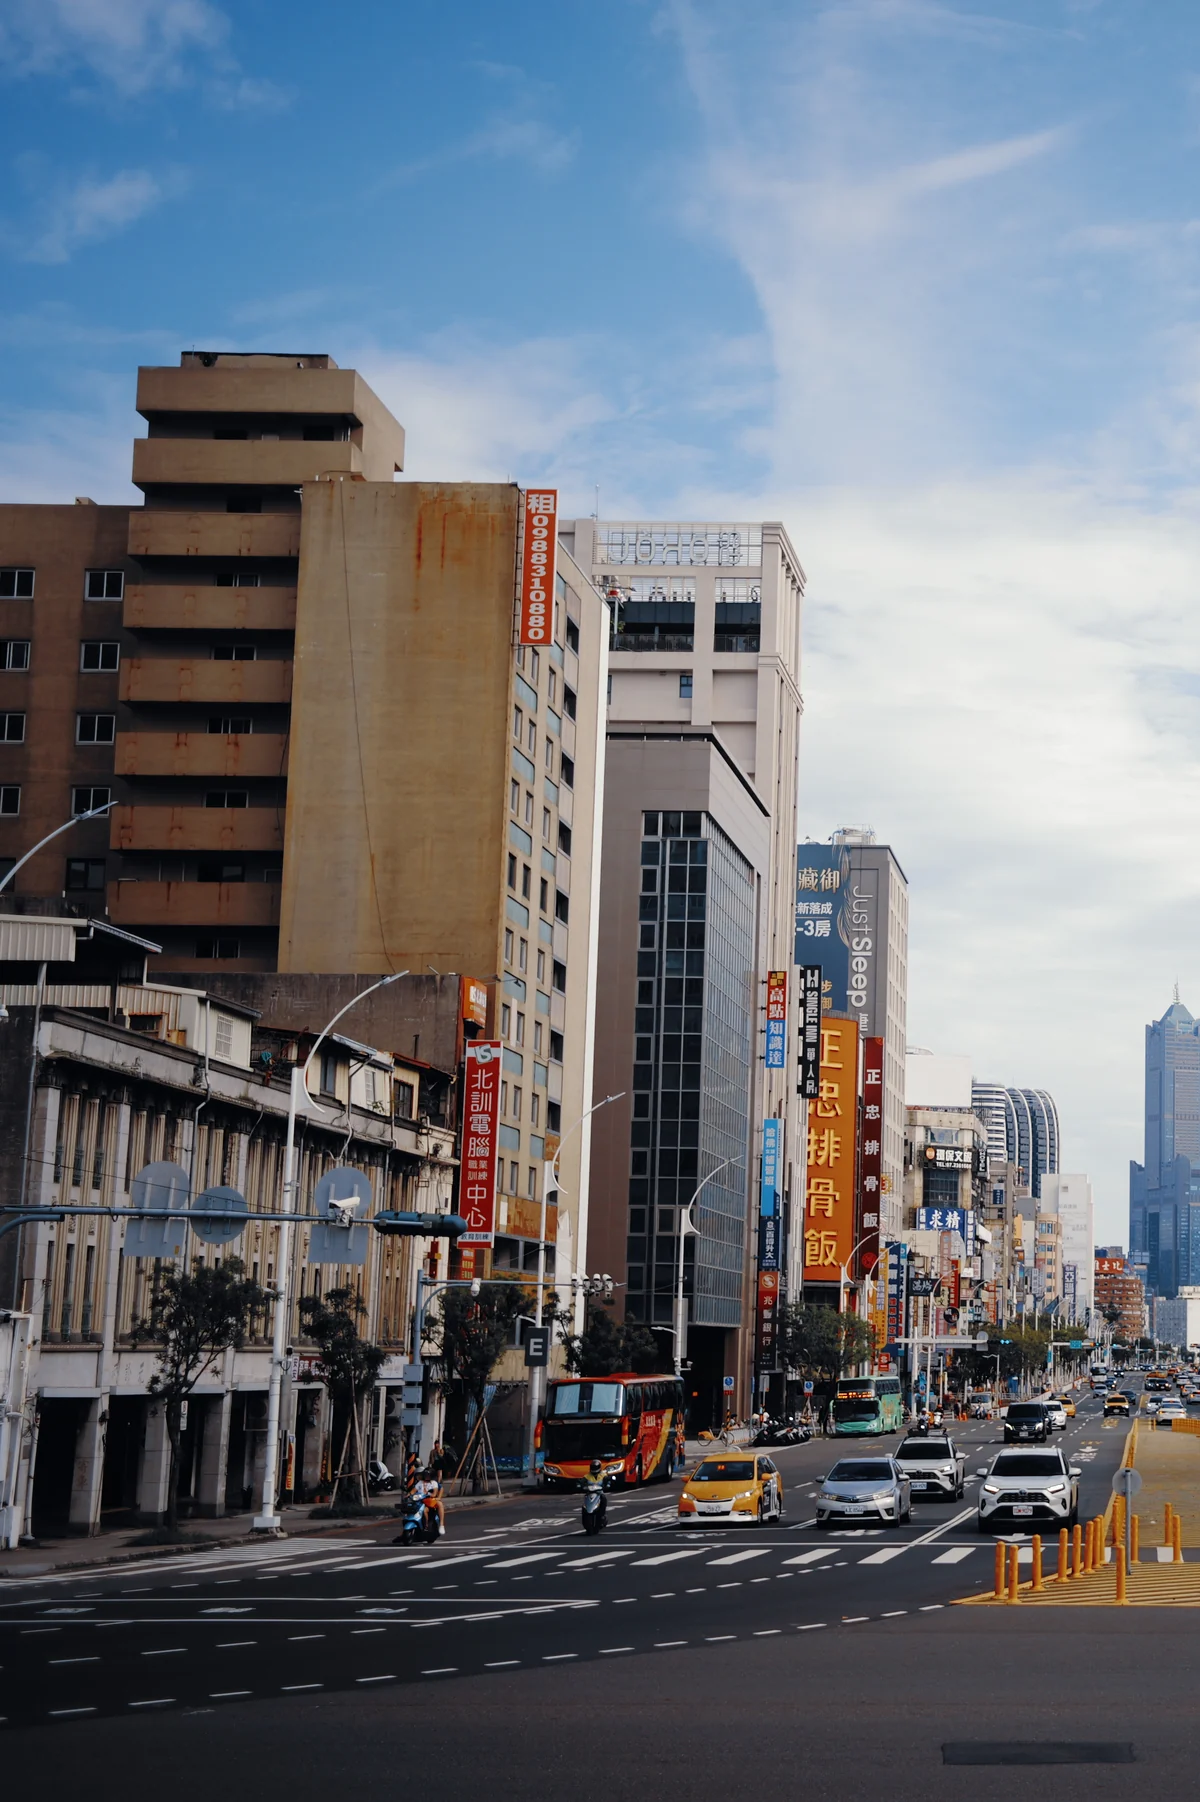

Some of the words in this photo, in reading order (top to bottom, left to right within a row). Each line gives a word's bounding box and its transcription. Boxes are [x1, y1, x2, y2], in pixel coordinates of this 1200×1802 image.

[795, 901, 833, 915] 新落成
[852, 885, 873, 935] Just
[846, 936, 873, 1008] Sleep
[768, 987, 785, 1019] 高點
[806, 990, 818, 1023] SINGLE
[767, 1021, 784, 1065] 知識達
[805, 1025, 818, 1043] INN
[804, 1028, 844, 1267] 正忠排骨飯
[863, 1068, 882, 1229] 正忠排骨飯
[530, 1338, 544, 1356] E
